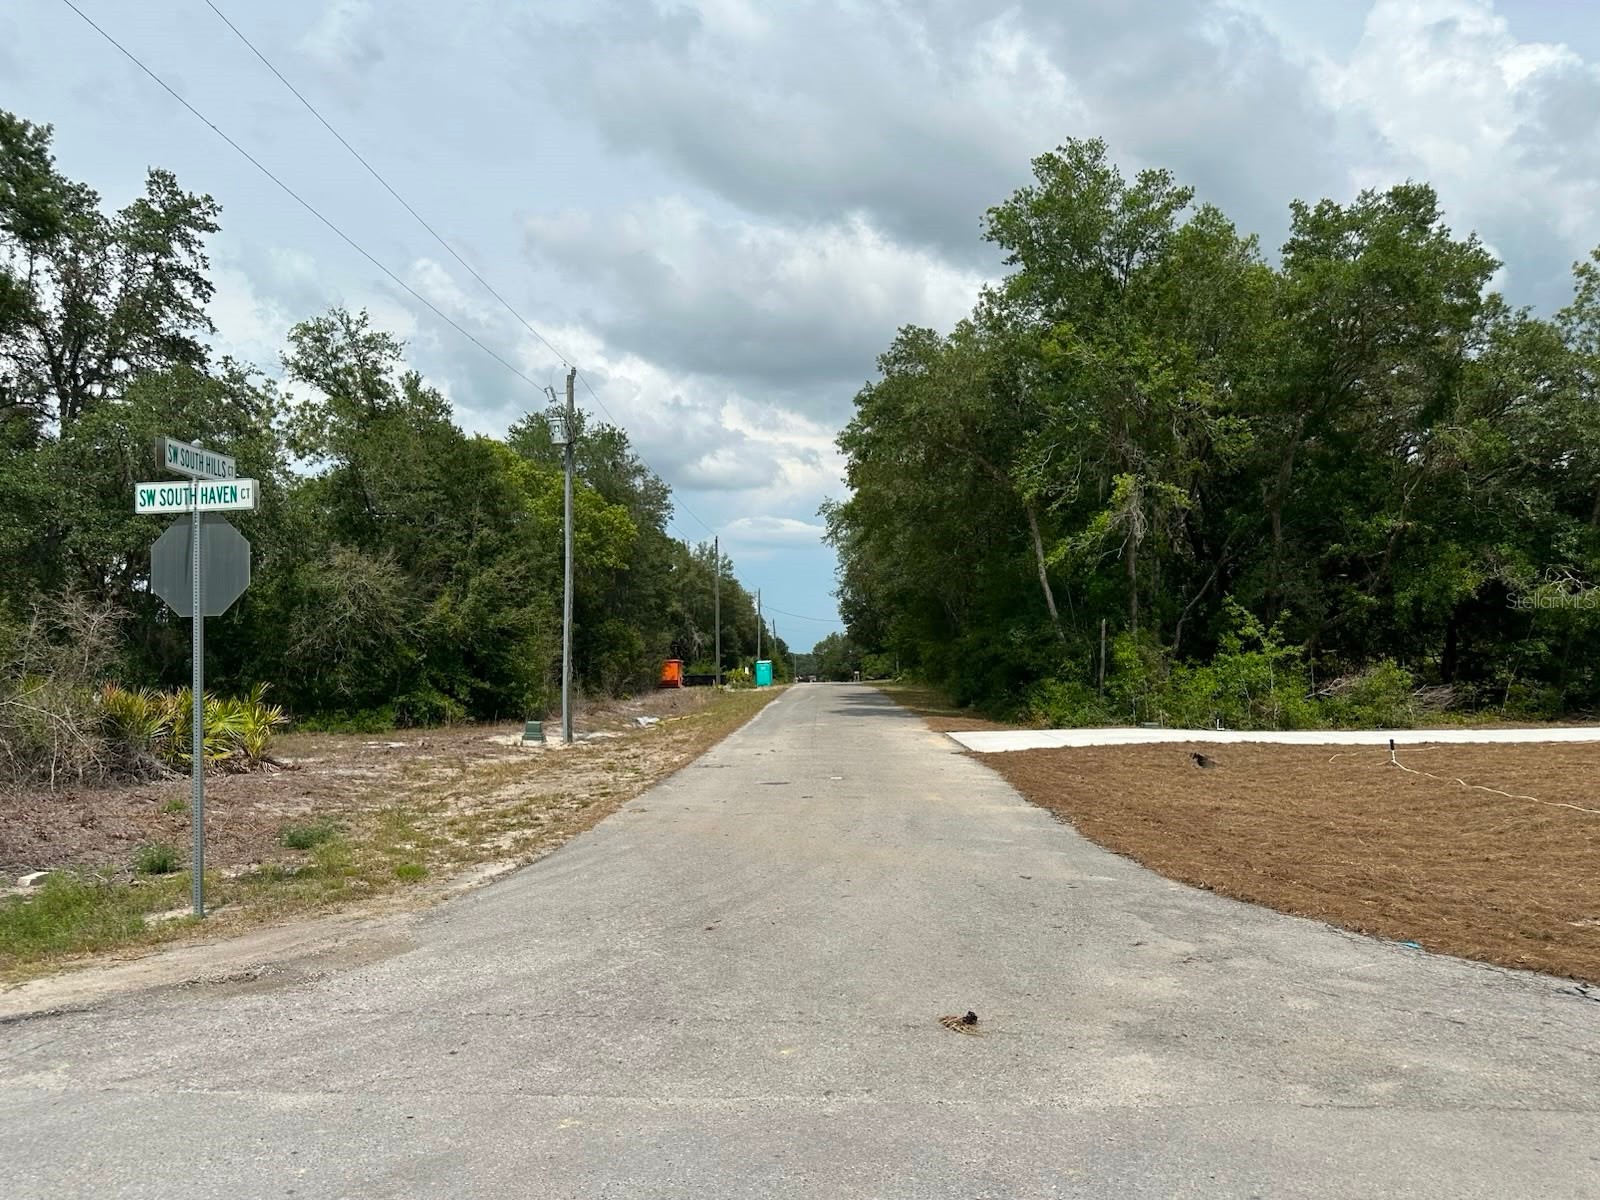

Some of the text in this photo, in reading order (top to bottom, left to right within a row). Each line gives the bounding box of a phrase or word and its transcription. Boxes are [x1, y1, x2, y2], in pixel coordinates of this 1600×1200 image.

[168, 444, 233, 477] SW SOUTH HILLS CT
[139, 485, 251, 507] SW SOUTH HAVEN CT
